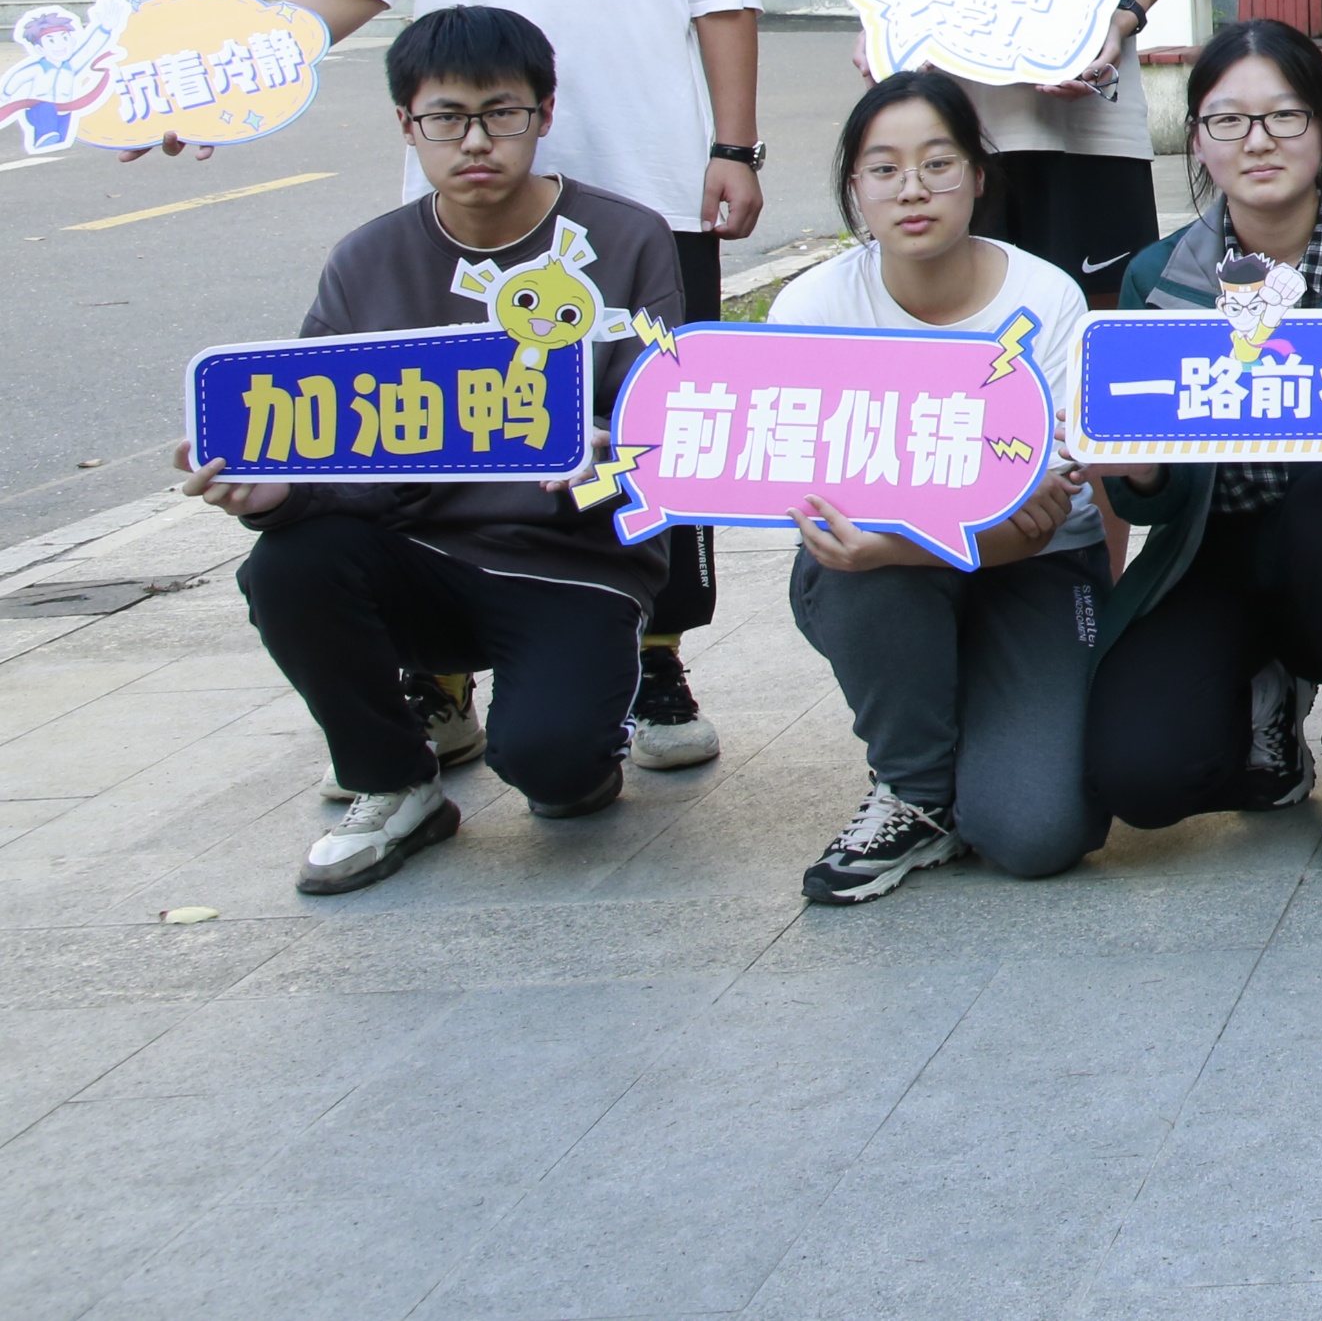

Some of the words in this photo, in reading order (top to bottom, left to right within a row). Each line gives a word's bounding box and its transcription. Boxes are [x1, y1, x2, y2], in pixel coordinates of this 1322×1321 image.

[115, 28, 306, 123] 沉着冷静
[241, 361, 550, 463] 加油鸭
[658, 381, 985, 488] 前程似锦
